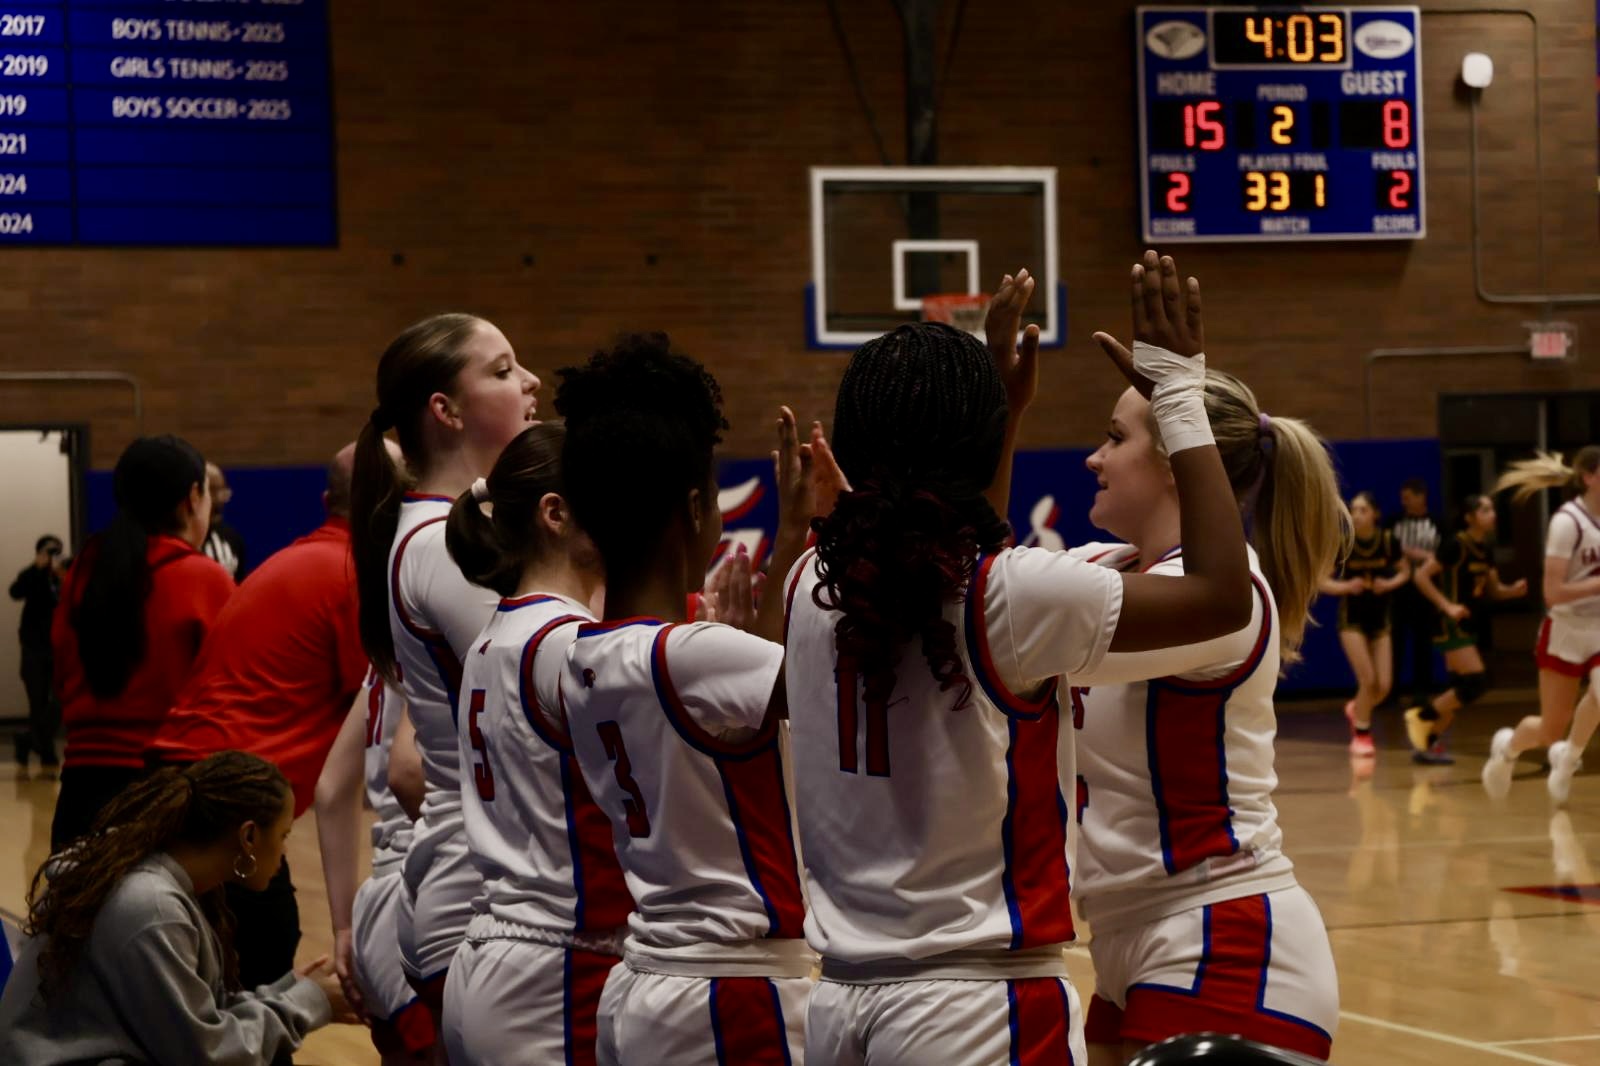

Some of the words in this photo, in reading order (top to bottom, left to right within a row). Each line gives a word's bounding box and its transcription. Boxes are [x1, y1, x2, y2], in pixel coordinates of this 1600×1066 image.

[111, 18, 162, 40] BOYS
[1245, 14, 1343, 62] 4:03
[110, 56, 165, 78] GIRLS
[1157, 72, 1216, 95] HOME
[1341, 70, 1407, 95] GUEST
[112, 96, 162, 118] BOYS
[1184, 101, 1225, 150] 15
[1271, 105, 1294, 144] 2
[1383, 100, 1410, 148] 8
[1167, 172, 1190, 212] 2
[1246, 172, 1290, 211] 33
[1315, 174, 1325, 208] 1
[1389, 171, 1410, 209] 2
[834, 656, 891, 777] 11
[469, 689, 495, 801] 5
[596, 720, 650, 838] 3
